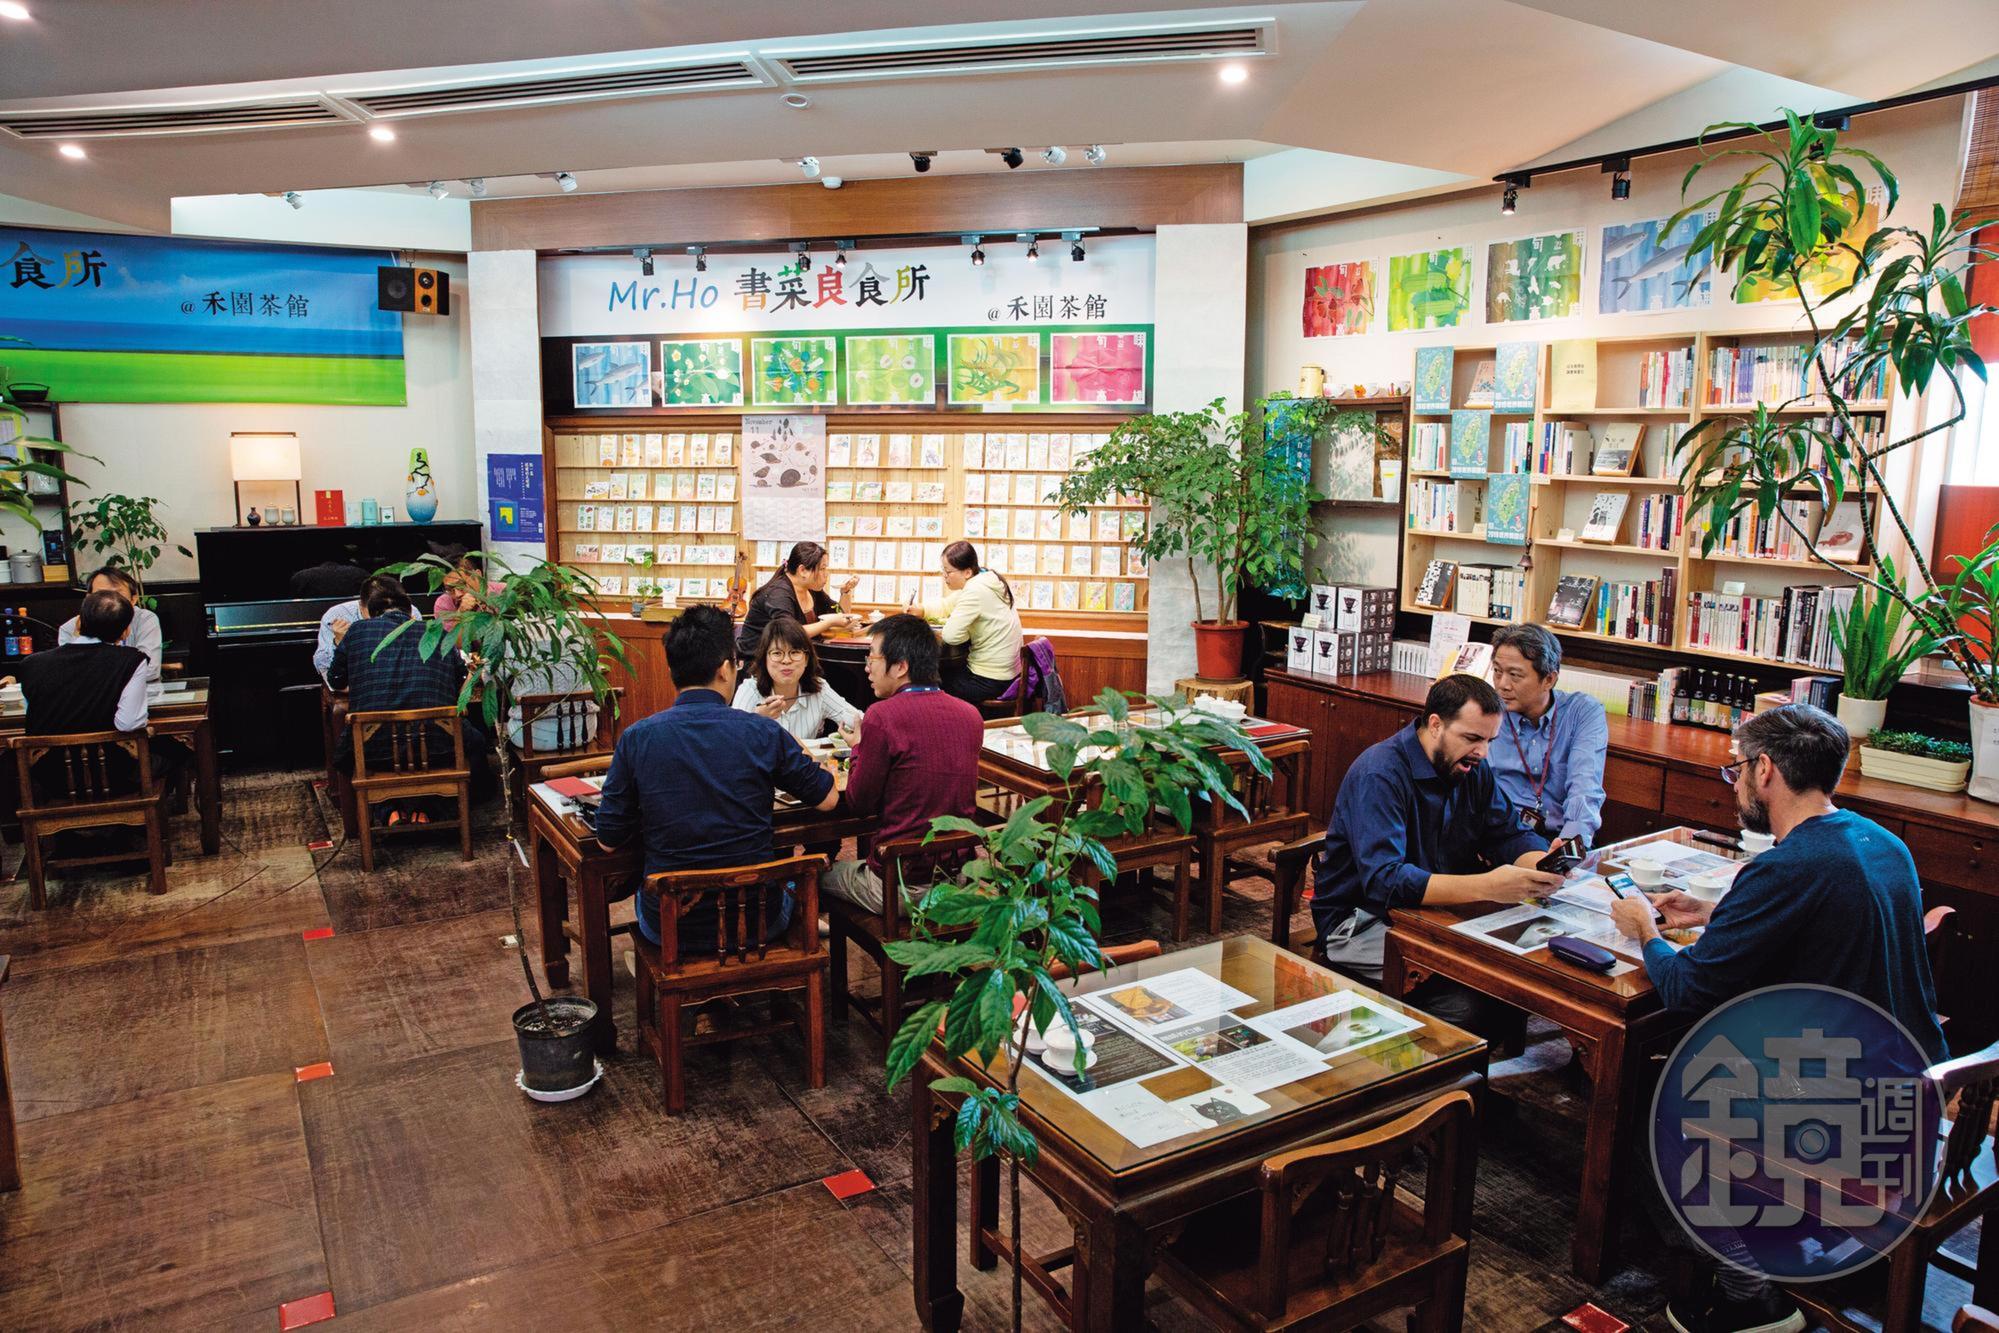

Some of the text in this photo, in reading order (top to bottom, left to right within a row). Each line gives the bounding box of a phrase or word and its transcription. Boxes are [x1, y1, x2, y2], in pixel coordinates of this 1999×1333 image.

[0, 241, 107, 289] 食所
[608, 262, 931, 314] Mr.Ho 書菜良食所
